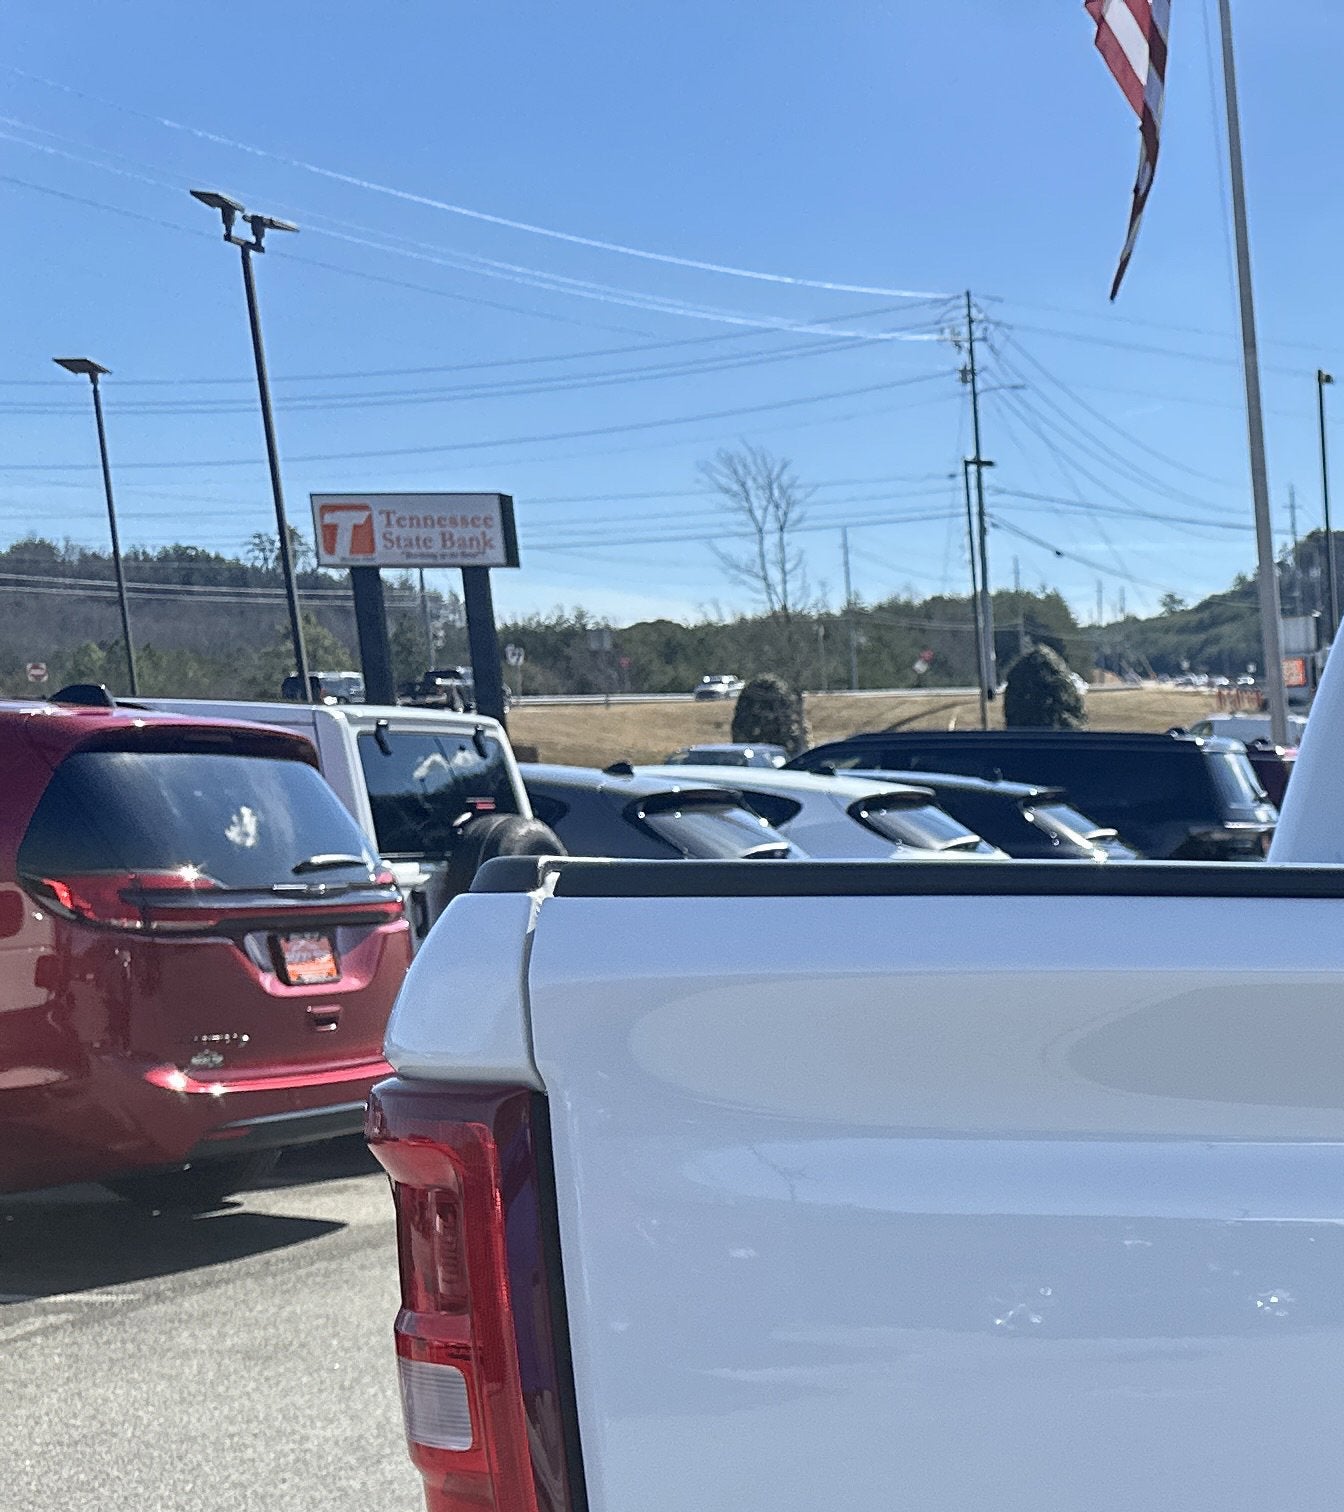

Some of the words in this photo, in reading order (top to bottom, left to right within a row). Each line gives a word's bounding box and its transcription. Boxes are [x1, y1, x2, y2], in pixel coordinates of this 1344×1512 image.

[379, 510, 495, 529] Tennessee
[381, 532, 434, 550] State
[440, 531, 496, 551] Bank
